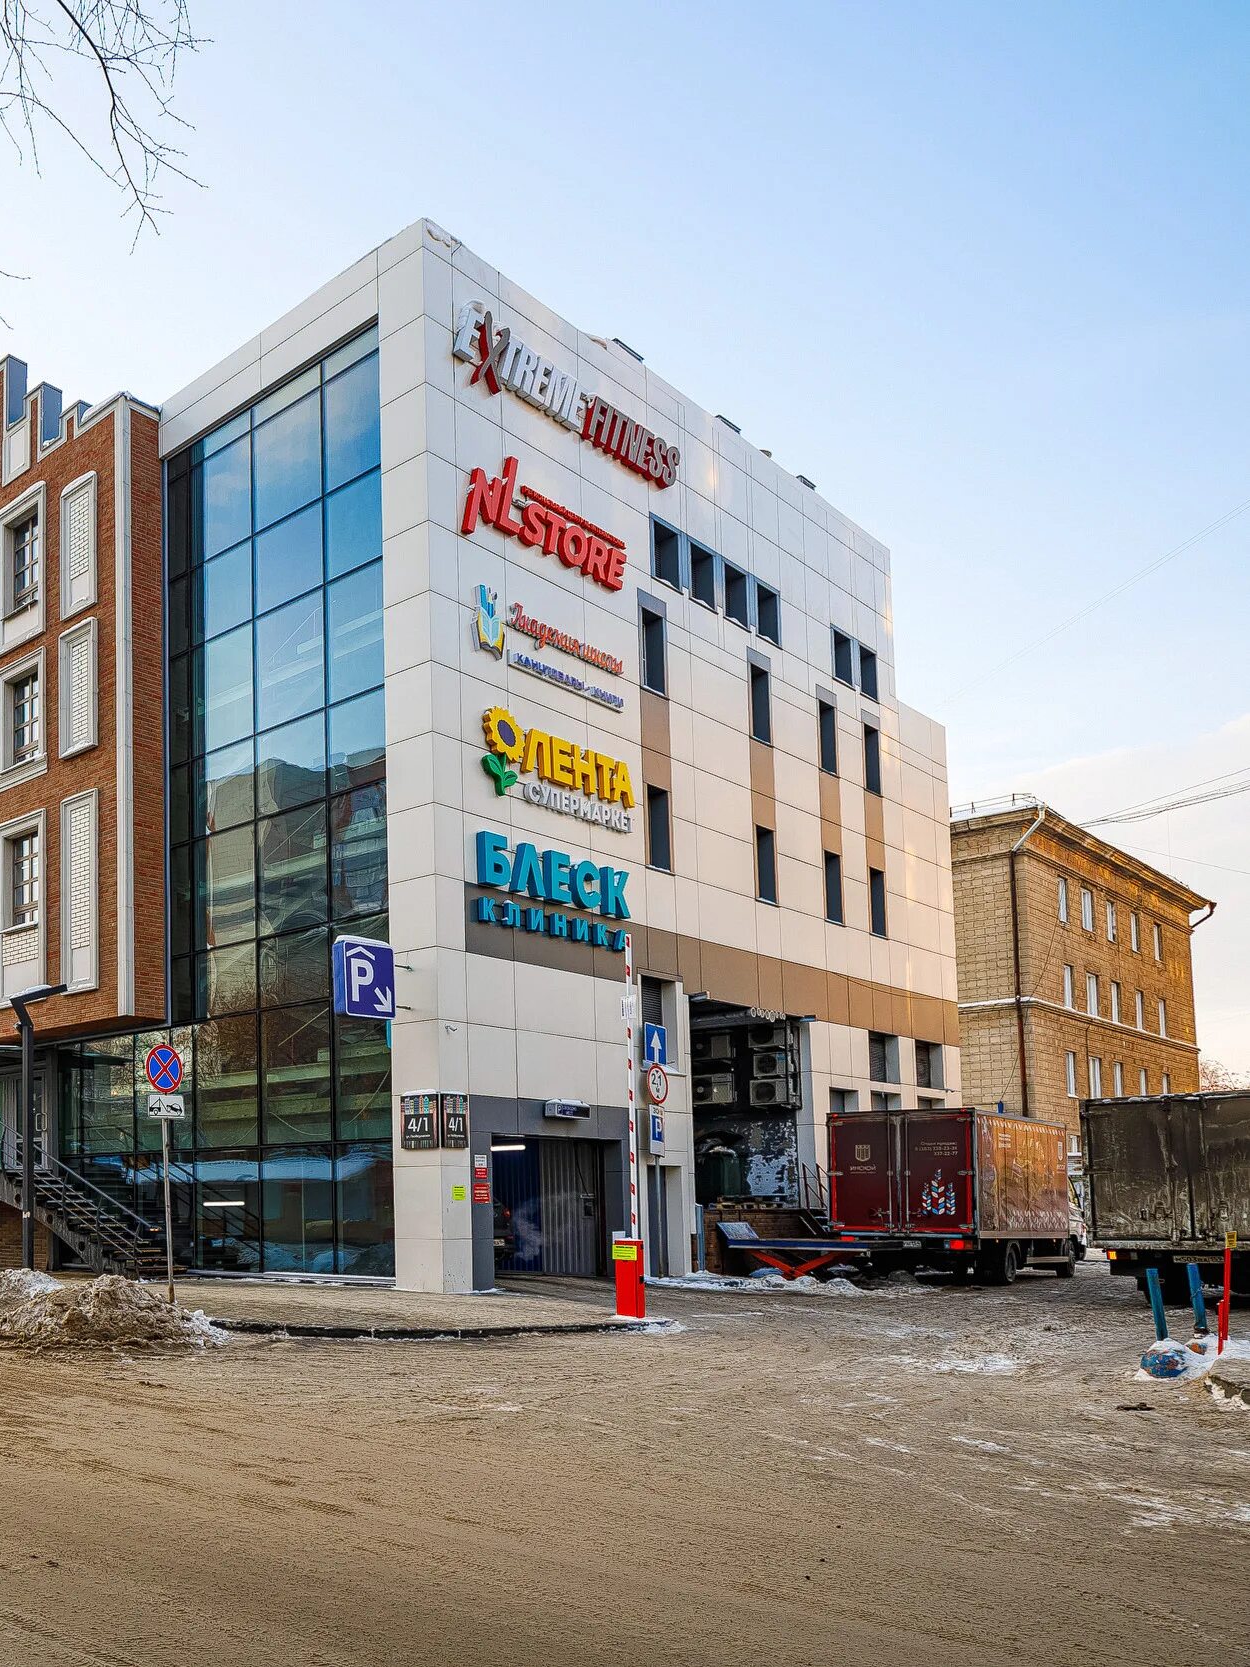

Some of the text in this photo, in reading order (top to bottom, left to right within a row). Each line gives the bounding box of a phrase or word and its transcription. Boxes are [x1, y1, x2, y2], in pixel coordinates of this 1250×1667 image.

[453, 304, 681, 490] EXTREME FITNESS
[519, 503, 627, 591] STORE
[521, 728, 635, 808] ЛЕНТА
[524, 781, 634, 834] СУПЕРМАРКЕТ
[476, 831, 631, 918] БЛЕСК
[478, 896, 631, 951] КЛИНИКА
[350, 957, 374, 1002] P
[407, 1117, 429, 1132] 4/1
[448, 1117, 463, 1132] 4/1
